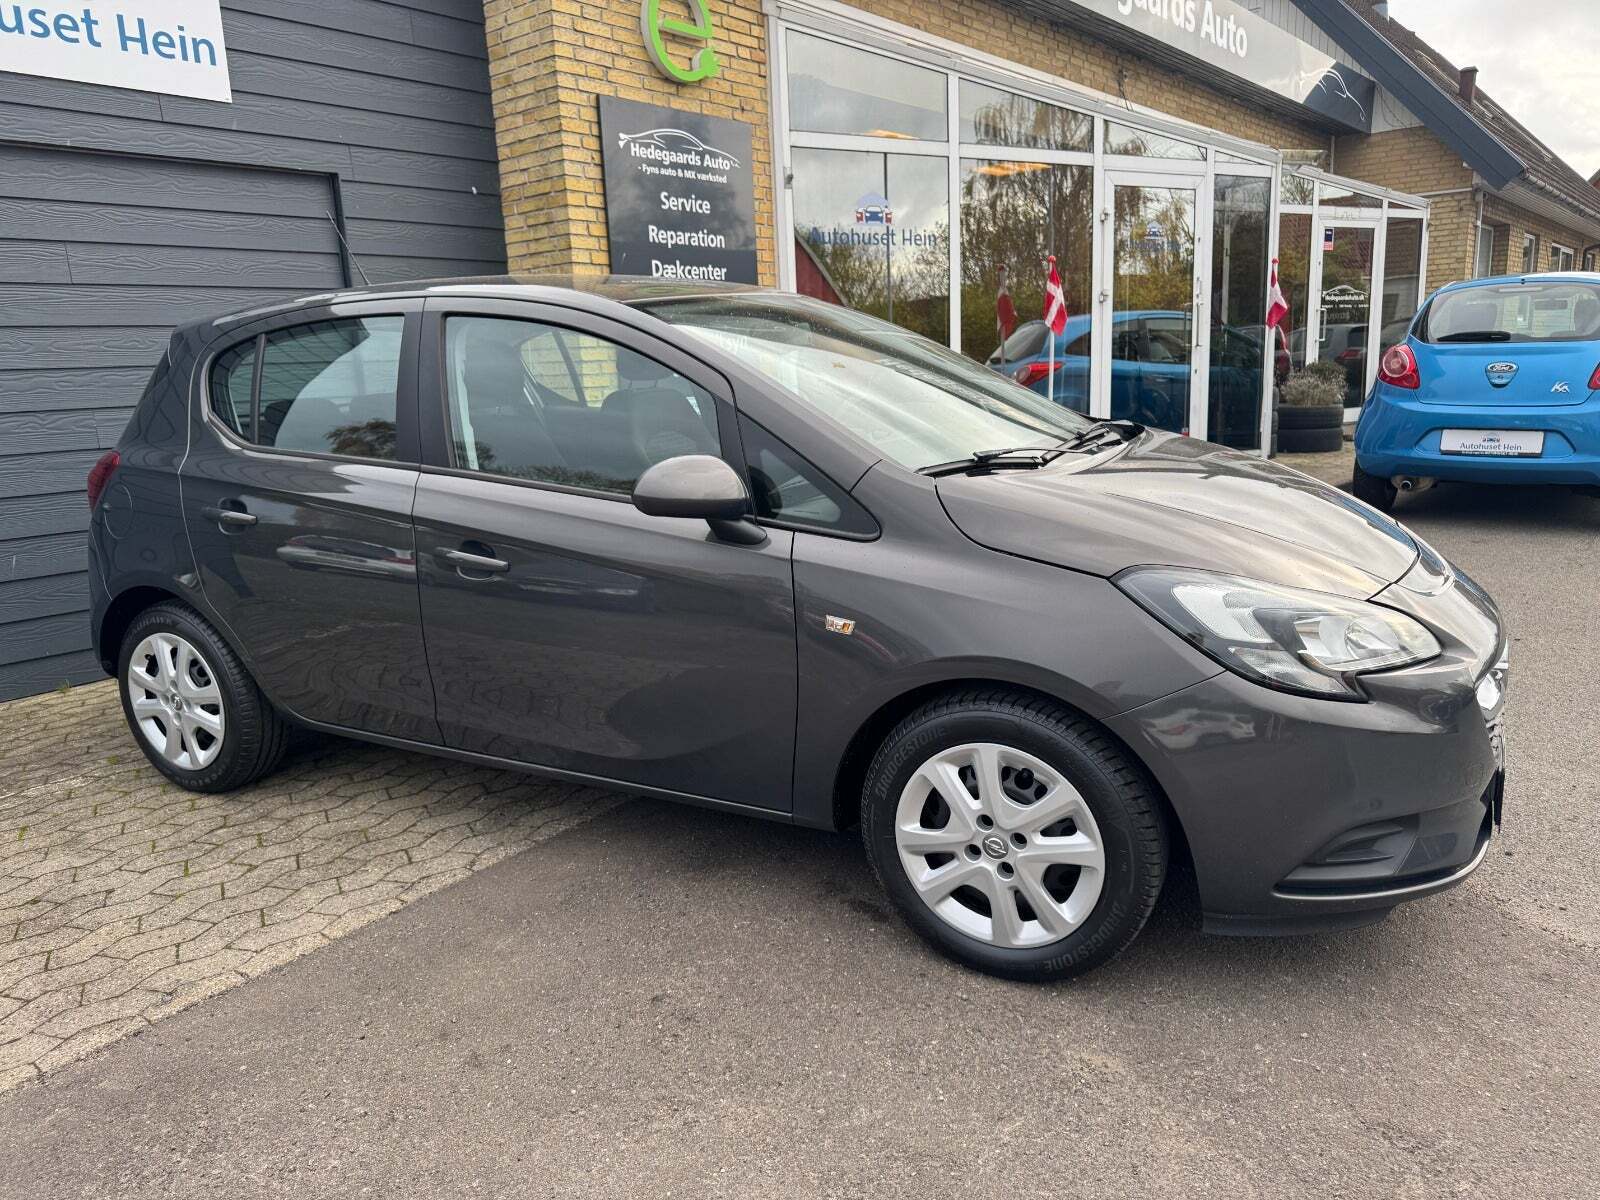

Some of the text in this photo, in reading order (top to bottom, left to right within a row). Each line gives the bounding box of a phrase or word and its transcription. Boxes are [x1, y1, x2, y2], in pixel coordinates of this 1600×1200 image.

[0, 5, 217, 66] uset Hein
[1200, 0, 1248, 58] Auto
[630, 142, 731, 170] Hedegaards Auto
[642, 164, 659, 175] Fyns
[660, 168, 677, 177] auto
[660, 191, 711, 214] Service
[648, 224, 726, 249] Reparation
[808, 227, 937, 246] Autohuset Hein
[651, 259, 727, 280] Dækcenter
[1460, 442, 1522, 451] Autohuset Hein
